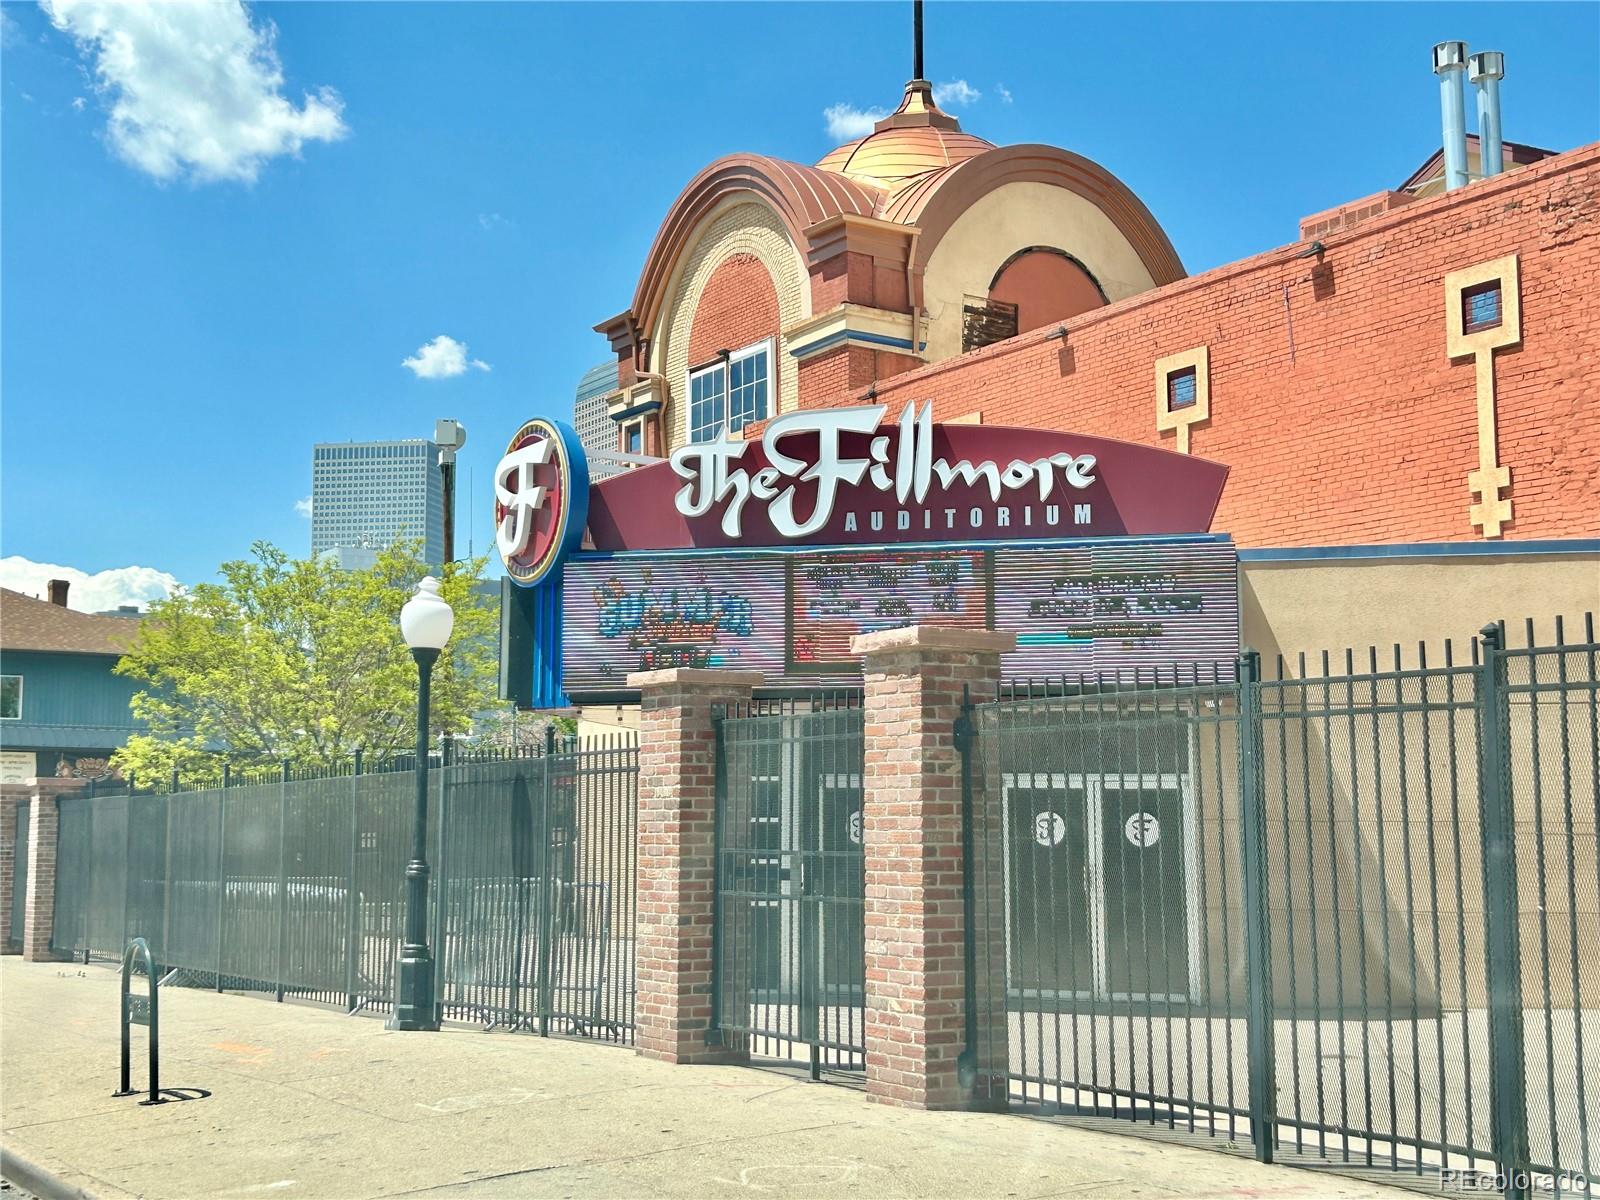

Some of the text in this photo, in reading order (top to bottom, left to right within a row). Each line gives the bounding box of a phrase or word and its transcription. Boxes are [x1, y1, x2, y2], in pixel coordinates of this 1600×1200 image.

[669, 399, 1097, 538] The Fillmore
[844, 503, 1092, 532] AUDITORIUM
